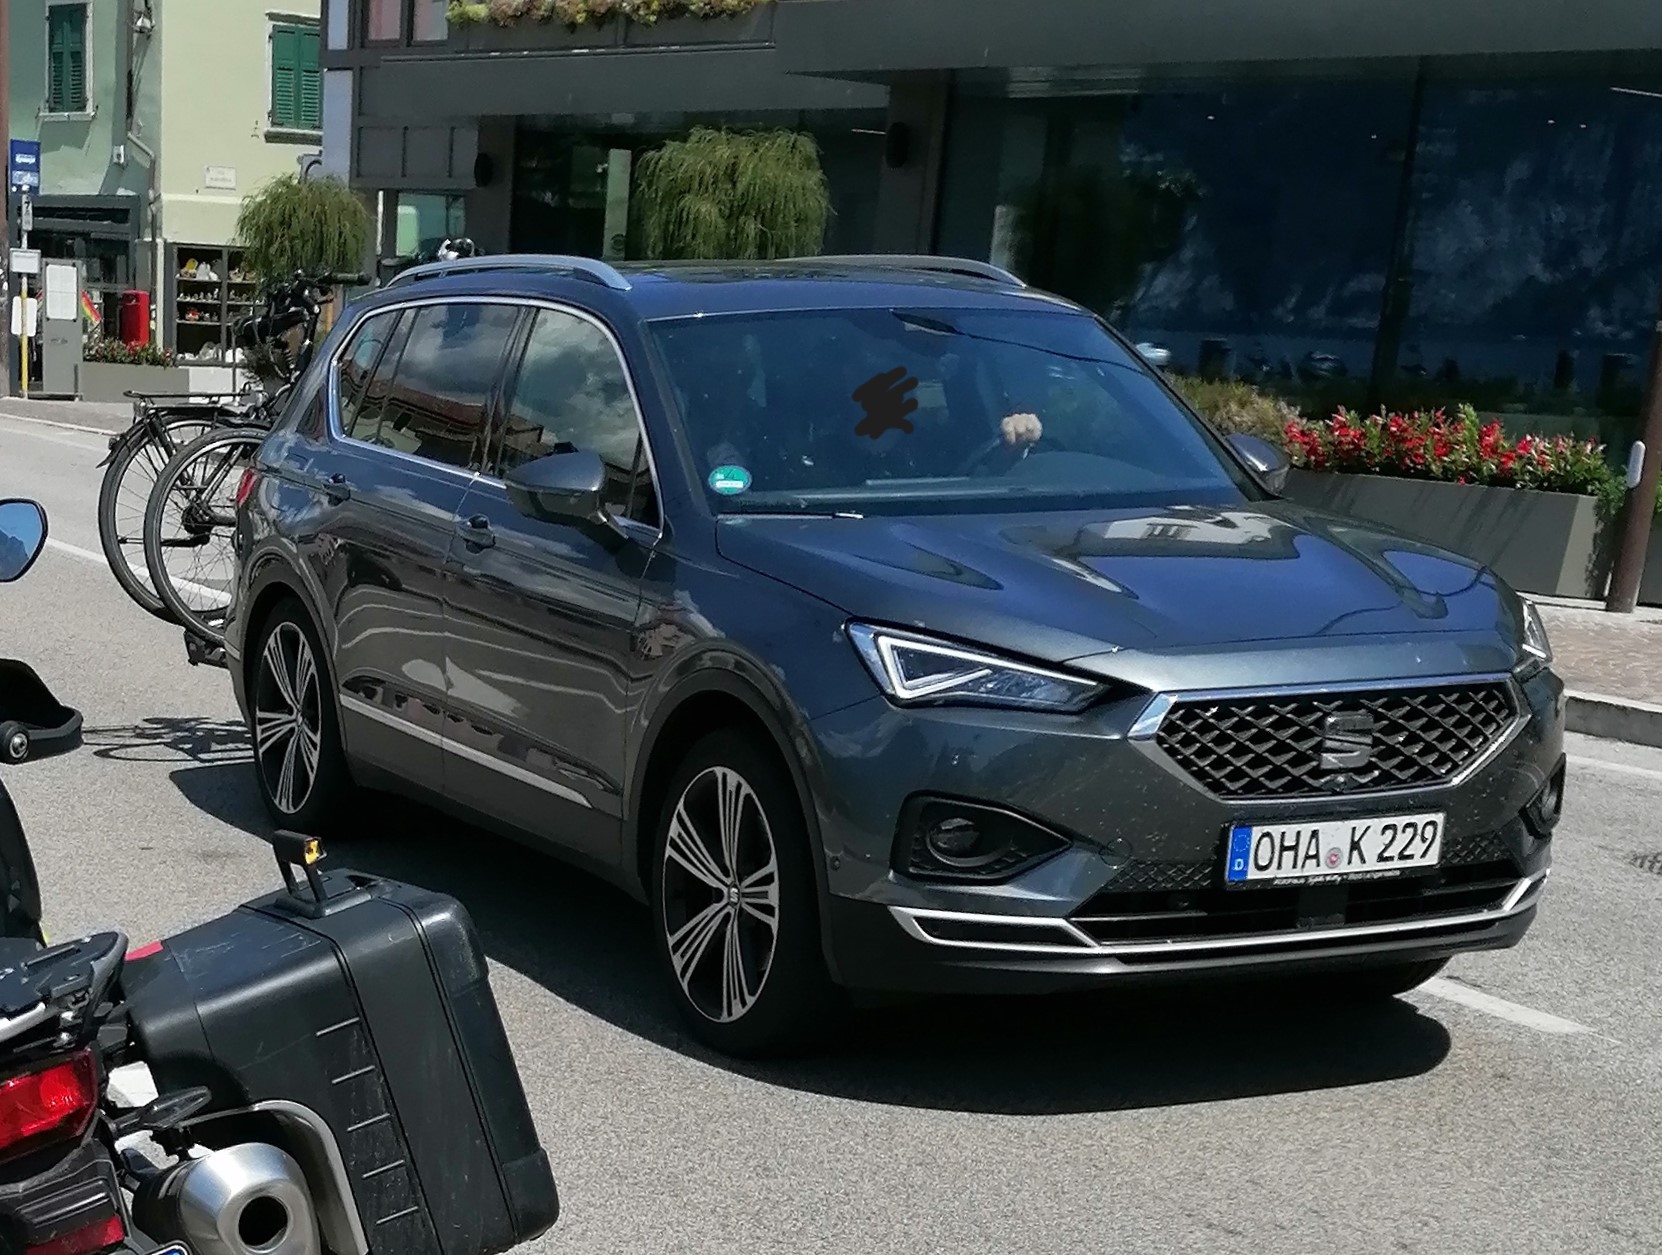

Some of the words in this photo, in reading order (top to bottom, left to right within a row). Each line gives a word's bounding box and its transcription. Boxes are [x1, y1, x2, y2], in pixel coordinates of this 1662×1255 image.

[1253, 829, 1321, 872] OHA
[1347, 825, 1371, 866] K
[1376, 820, 1438, 862] 229
[1234, 858, 1244, 871] D
